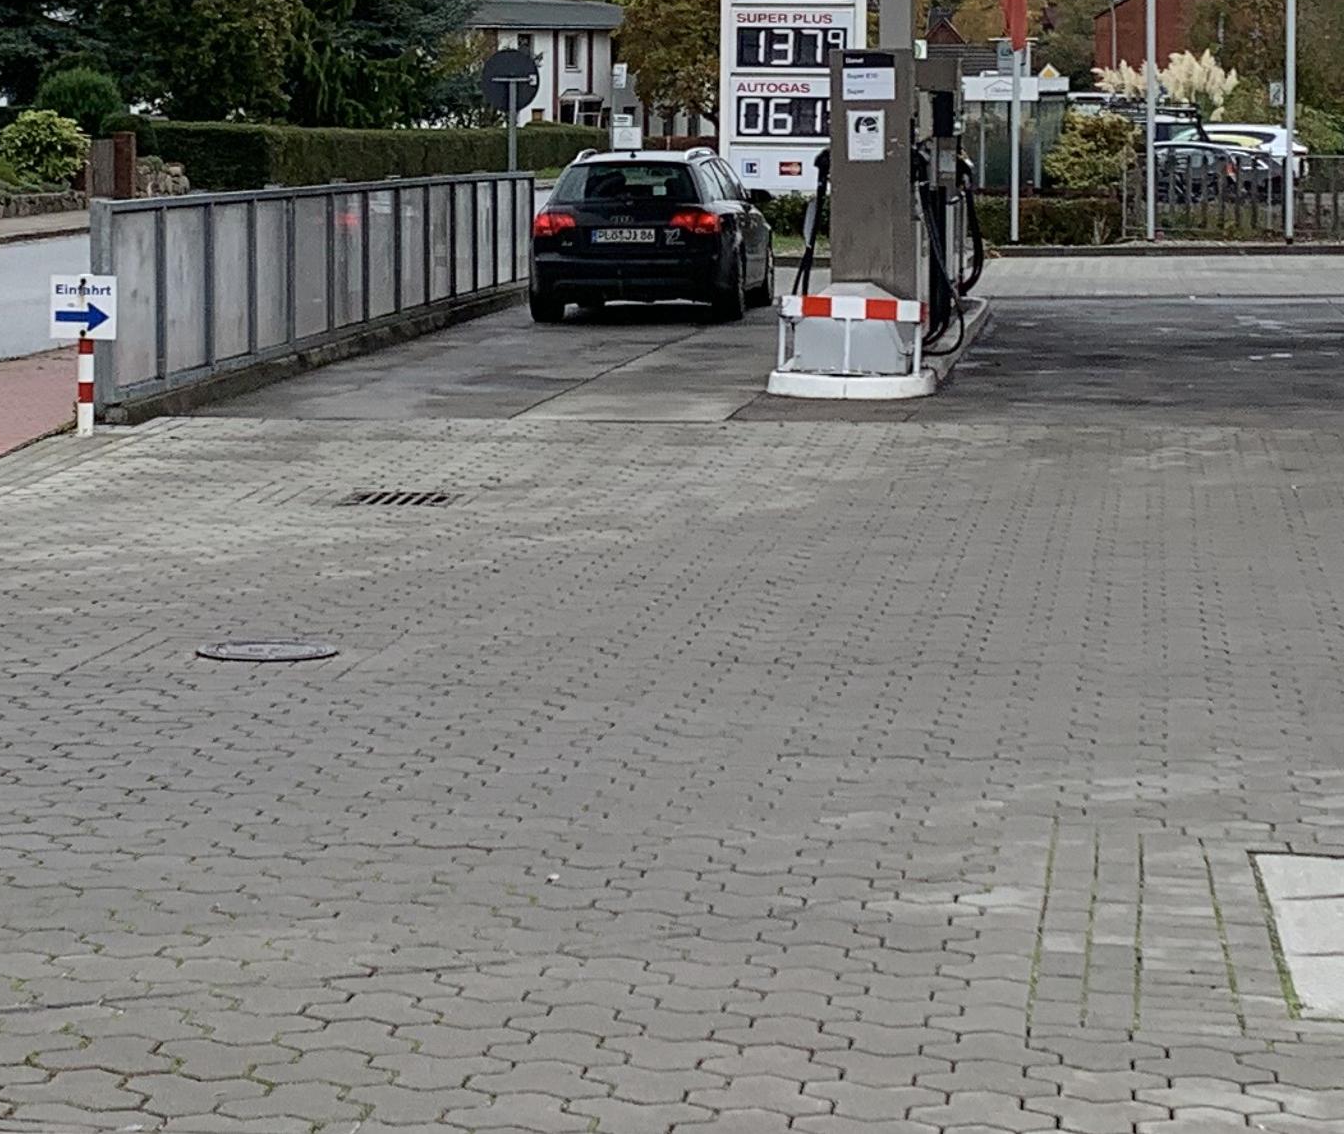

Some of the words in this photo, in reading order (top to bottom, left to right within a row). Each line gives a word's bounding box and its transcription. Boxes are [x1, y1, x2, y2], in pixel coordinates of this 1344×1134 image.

[736, 13, 788, 23] SUPER
[792, 13, 833, 24] PLUS
[736, 82, 811, 93] AUTOGAS
[55, 284, 112, 296] Einfahrt
